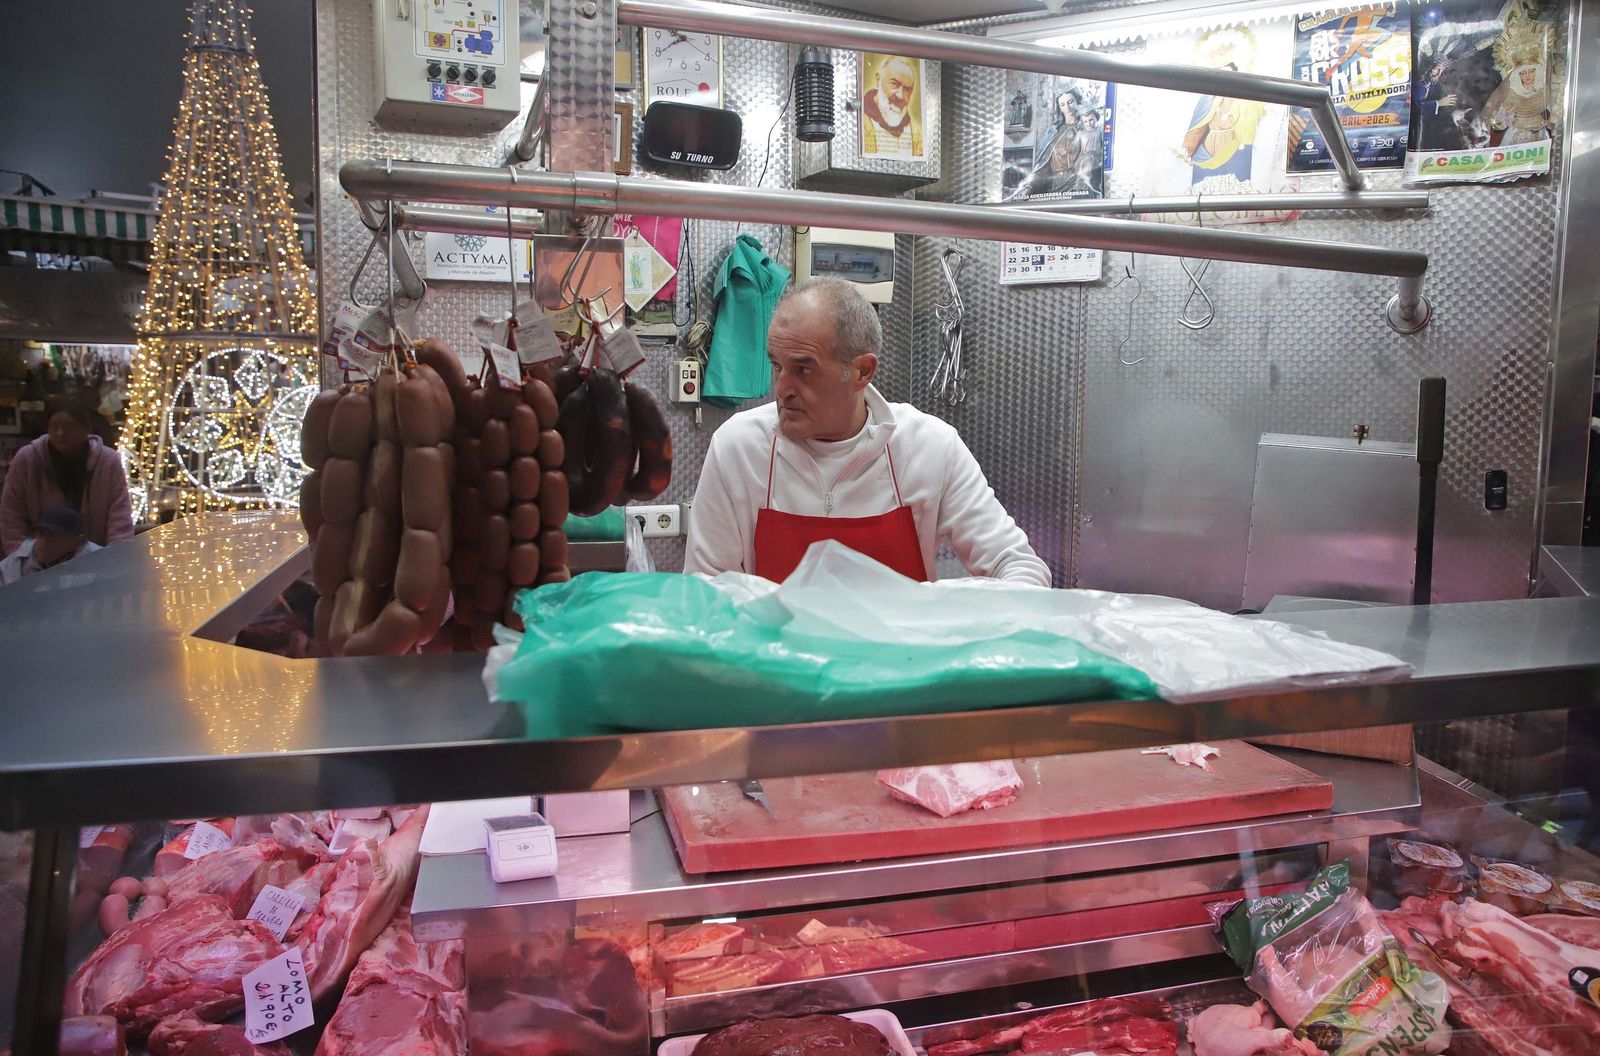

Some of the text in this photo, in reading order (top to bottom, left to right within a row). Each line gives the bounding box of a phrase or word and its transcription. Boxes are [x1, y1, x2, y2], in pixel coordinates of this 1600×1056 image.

[655, 30, 711, 46] 9 3
[655, 47, 711, 62] 8 4
[667, 57, 701, 71] 7 6 5
[671, 151, 714, 164] SU TURNO
[1437, 147, 1544, 167] CASA DIONI
[433, 251, 508, 265] ACTYMA
[286, 959, 305, 1004] LOMO
[278, 983, 294, 1022] ALTO
